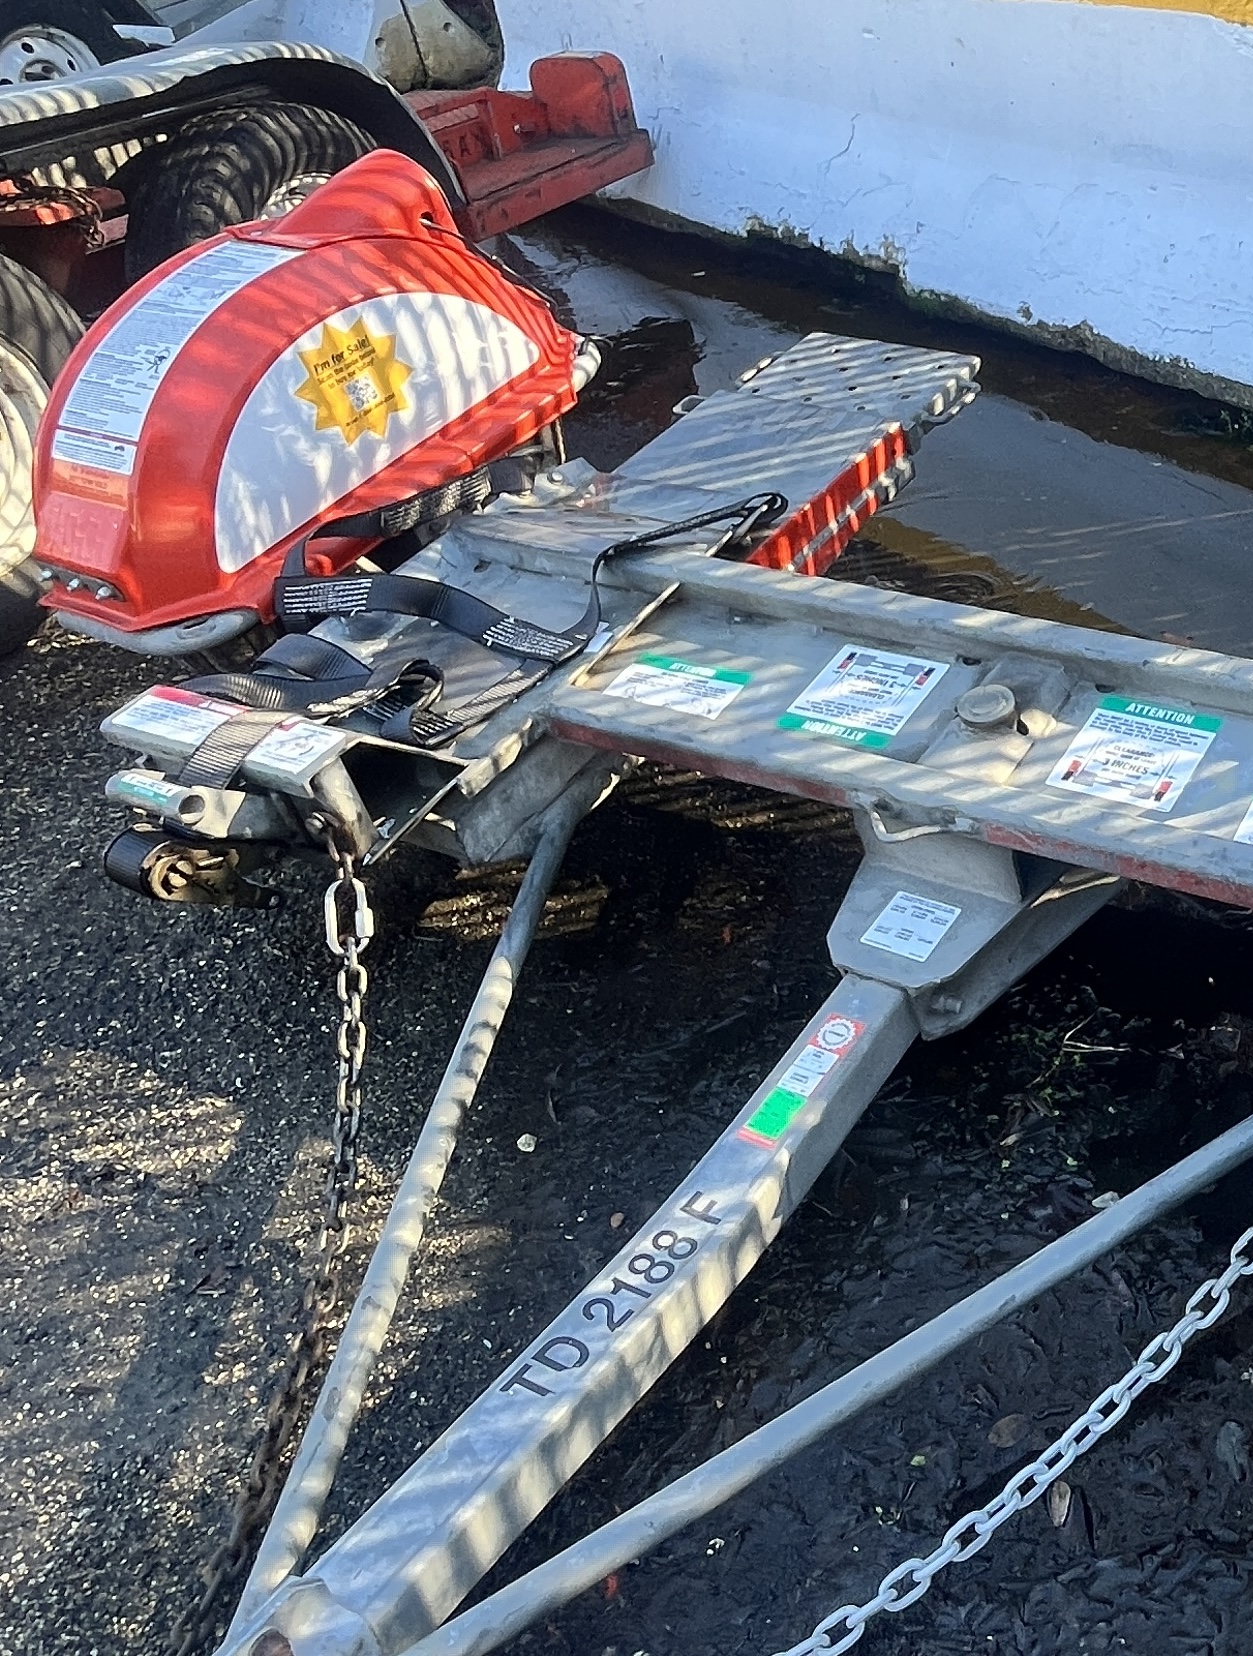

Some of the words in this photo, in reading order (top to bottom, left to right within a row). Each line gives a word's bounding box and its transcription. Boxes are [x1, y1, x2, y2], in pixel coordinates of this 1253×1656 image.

[313, 360, 331, 376] I'm
[331, 350, 345, 366] for
[346, 334, 372, 356] Sale!
[1123, 701, 1196, 724] ATTENTION
[801, 718, 868, 742] ATTENTION
[1110, 759, 1150, 774] INCHES
[499, 1335, 591, 1397] TD
[582, 1230, 699, 1333] 2188
[680, 1190, 722, 1226] F
